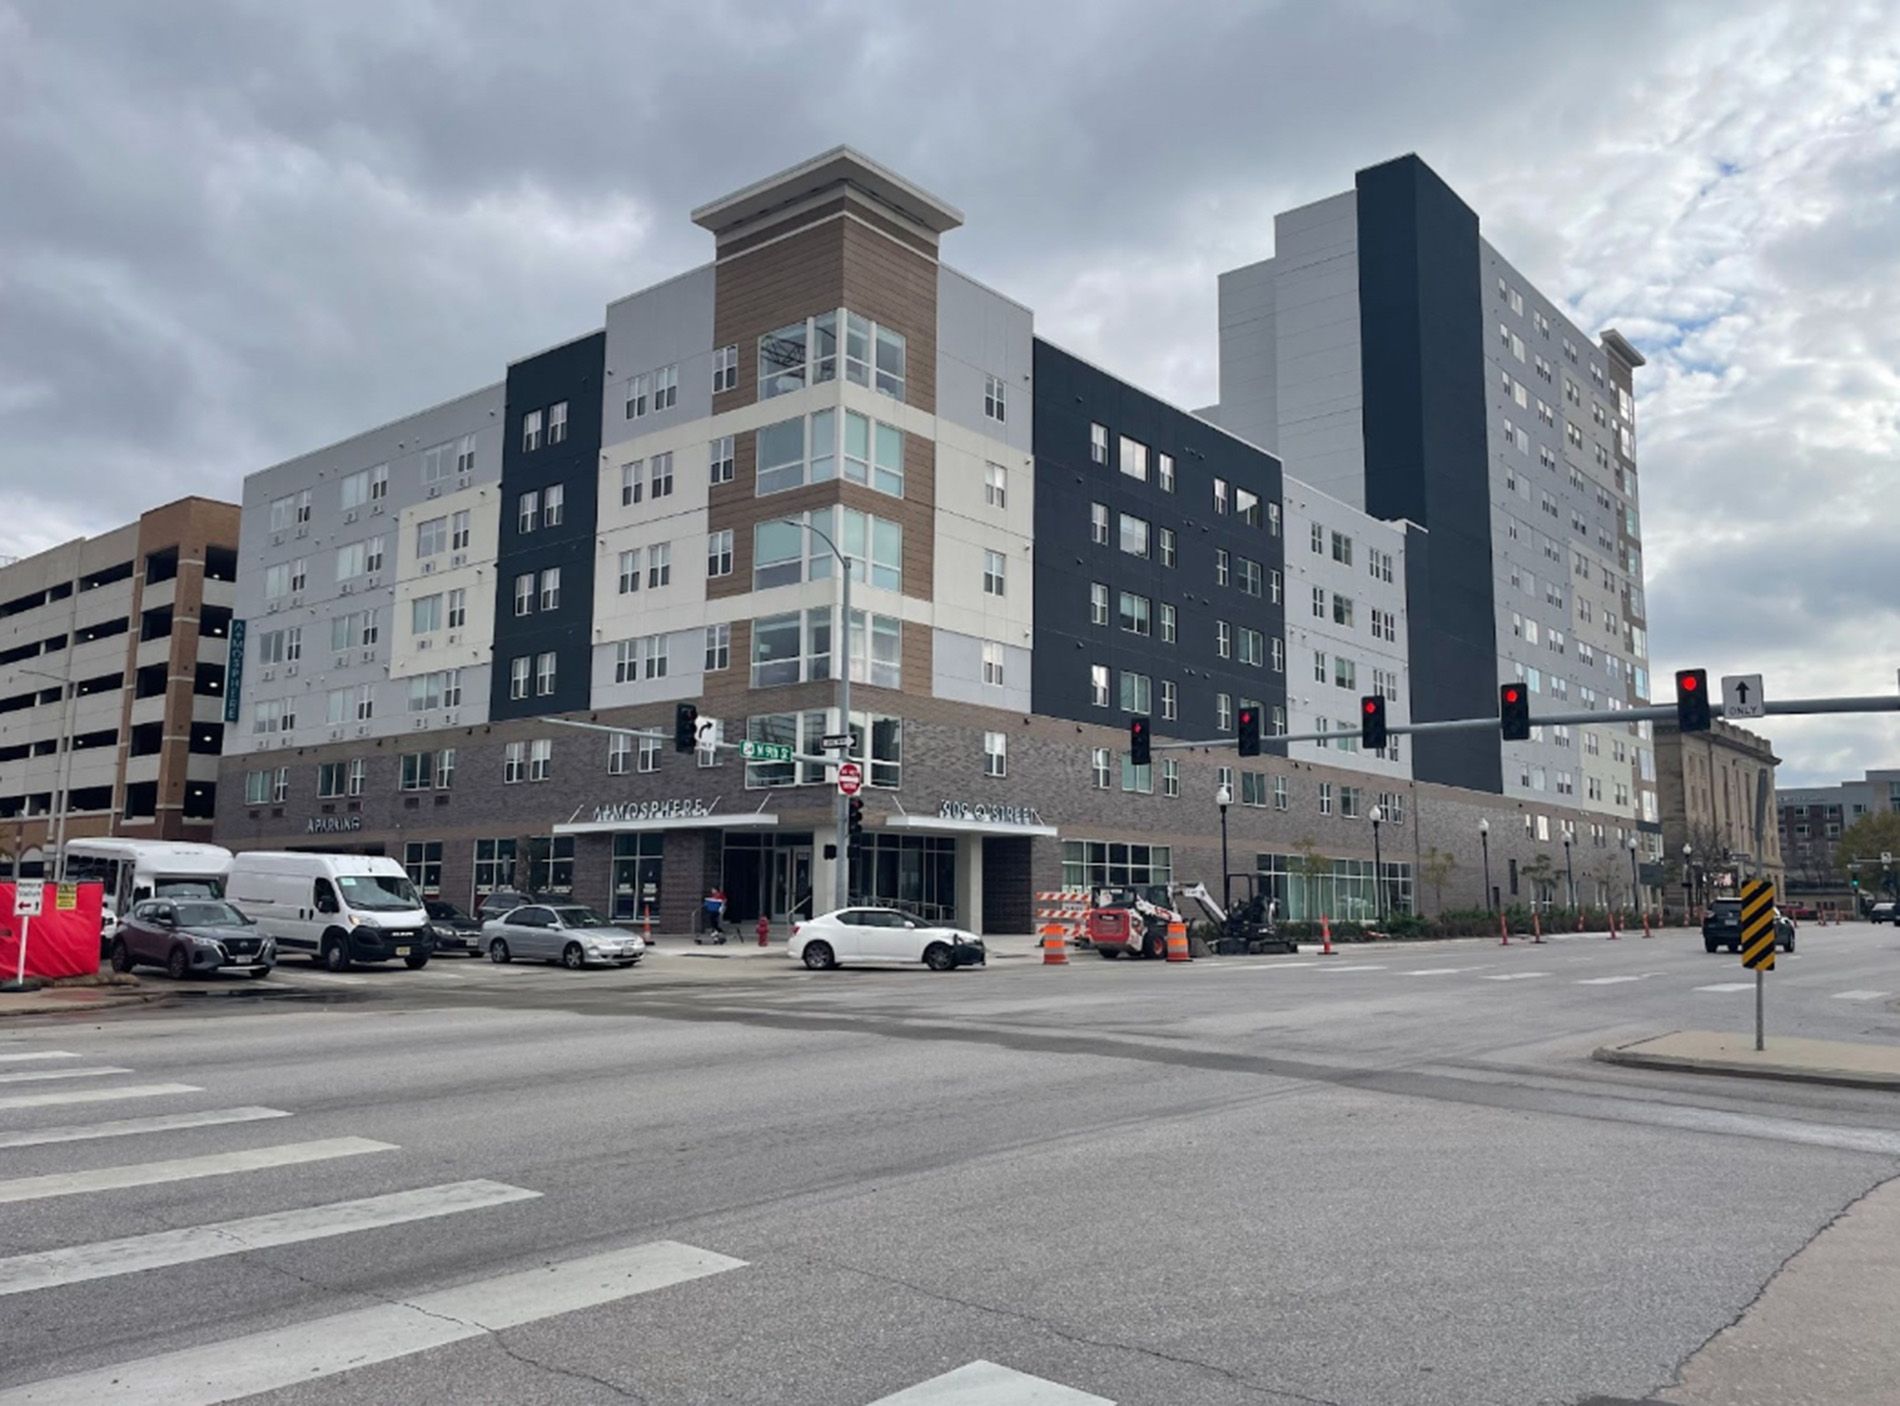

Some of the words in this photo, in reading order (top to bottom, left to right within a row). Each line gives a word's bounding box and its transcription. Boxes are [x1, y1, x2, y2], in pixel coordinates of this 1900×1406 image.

[1728, 705, 1758, 717] ONLY
[592, 799, 703, 821] ATMOSPHERE
[991, 804, 1040, 825] STREET
